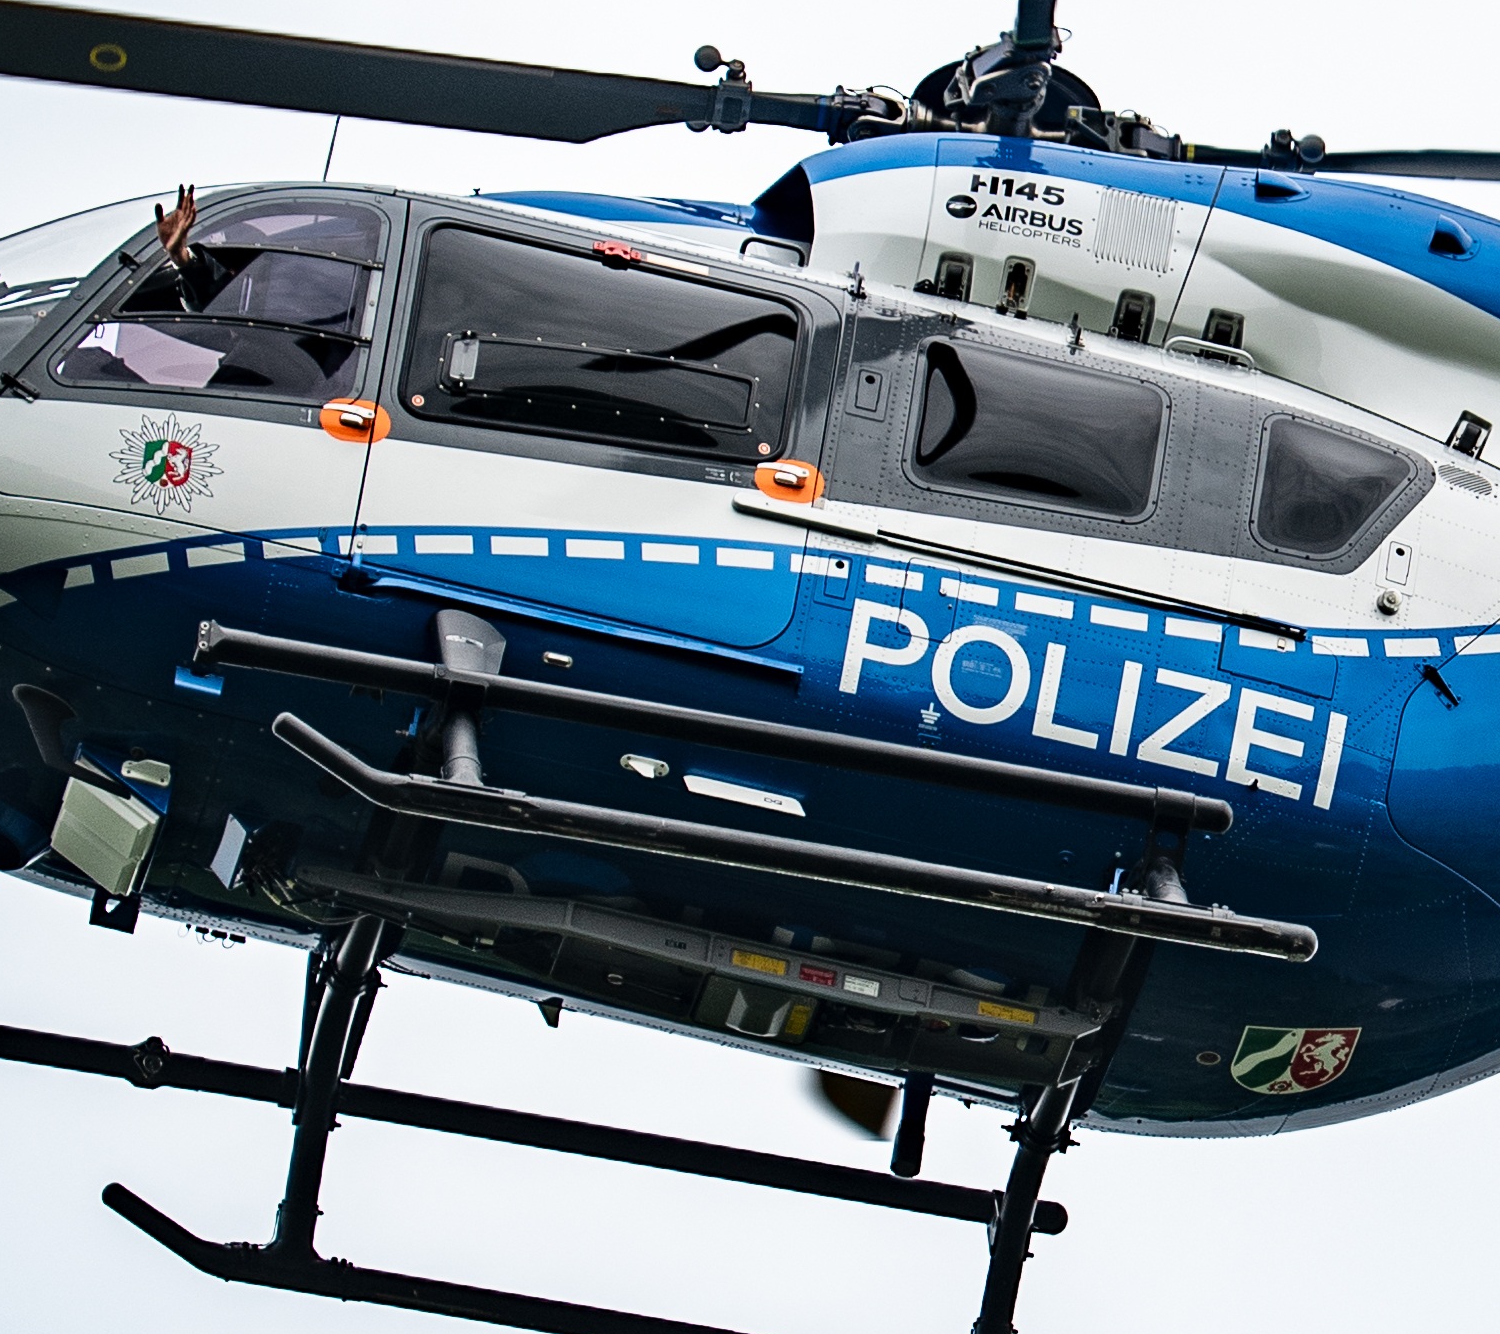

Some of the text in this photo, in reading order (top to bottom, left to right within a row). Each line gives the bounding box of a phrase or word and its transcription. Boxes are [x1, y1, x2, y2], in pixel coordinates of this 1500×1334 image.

[970, 174, 1065, 206] H145
[978, 219, 1082, 249] HELICOPTERS
[981, 203, 1083, 236] AIRBUS
[838, 598, 1349, 811] POLIZEI
